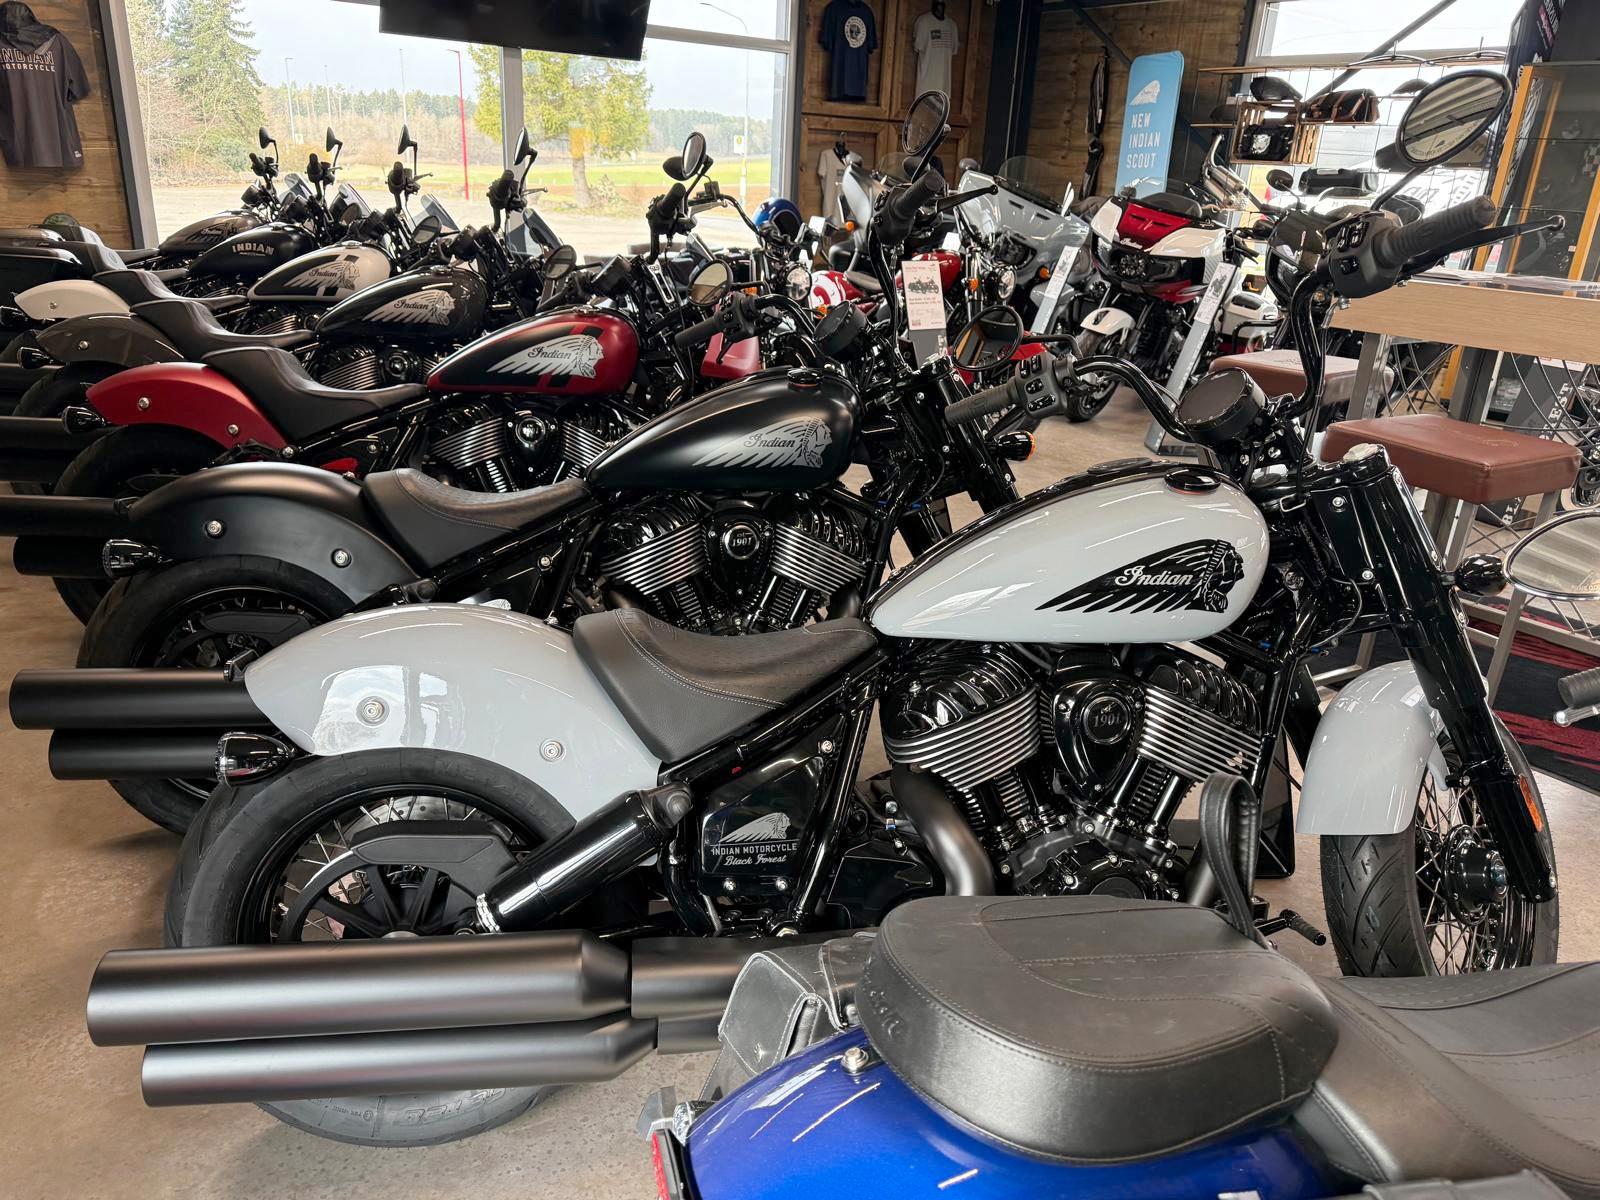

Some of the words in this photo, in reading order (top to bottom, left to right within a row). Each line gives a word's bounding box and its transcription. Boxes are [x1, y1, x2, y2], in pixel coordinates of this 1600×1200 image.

[0, 47, 55, 65] NDIAN
[1131, 112, 1152, 129] NEW
[1128, 131, 1161, 149] INDIAN
[1126, 152, 1157, 169] SCOUT
[232, 242, 275, 256] INDIAN
[308, 267, 338, 278] Indian
[393, 299, 430, 310] Indian
[527, 345, 572, 360] Indian
[743, 432, 796, 448] Indian
[732, 537, 752, 547] 1901
[1114, 565, 1194, 586] Indian
[711, 846, 741, 856] INDIAN
[742, 842, 798, 854] MOTORCYCLE
[723, 855, 753, 866] Black
[754, 853, 787, 865] Forest
